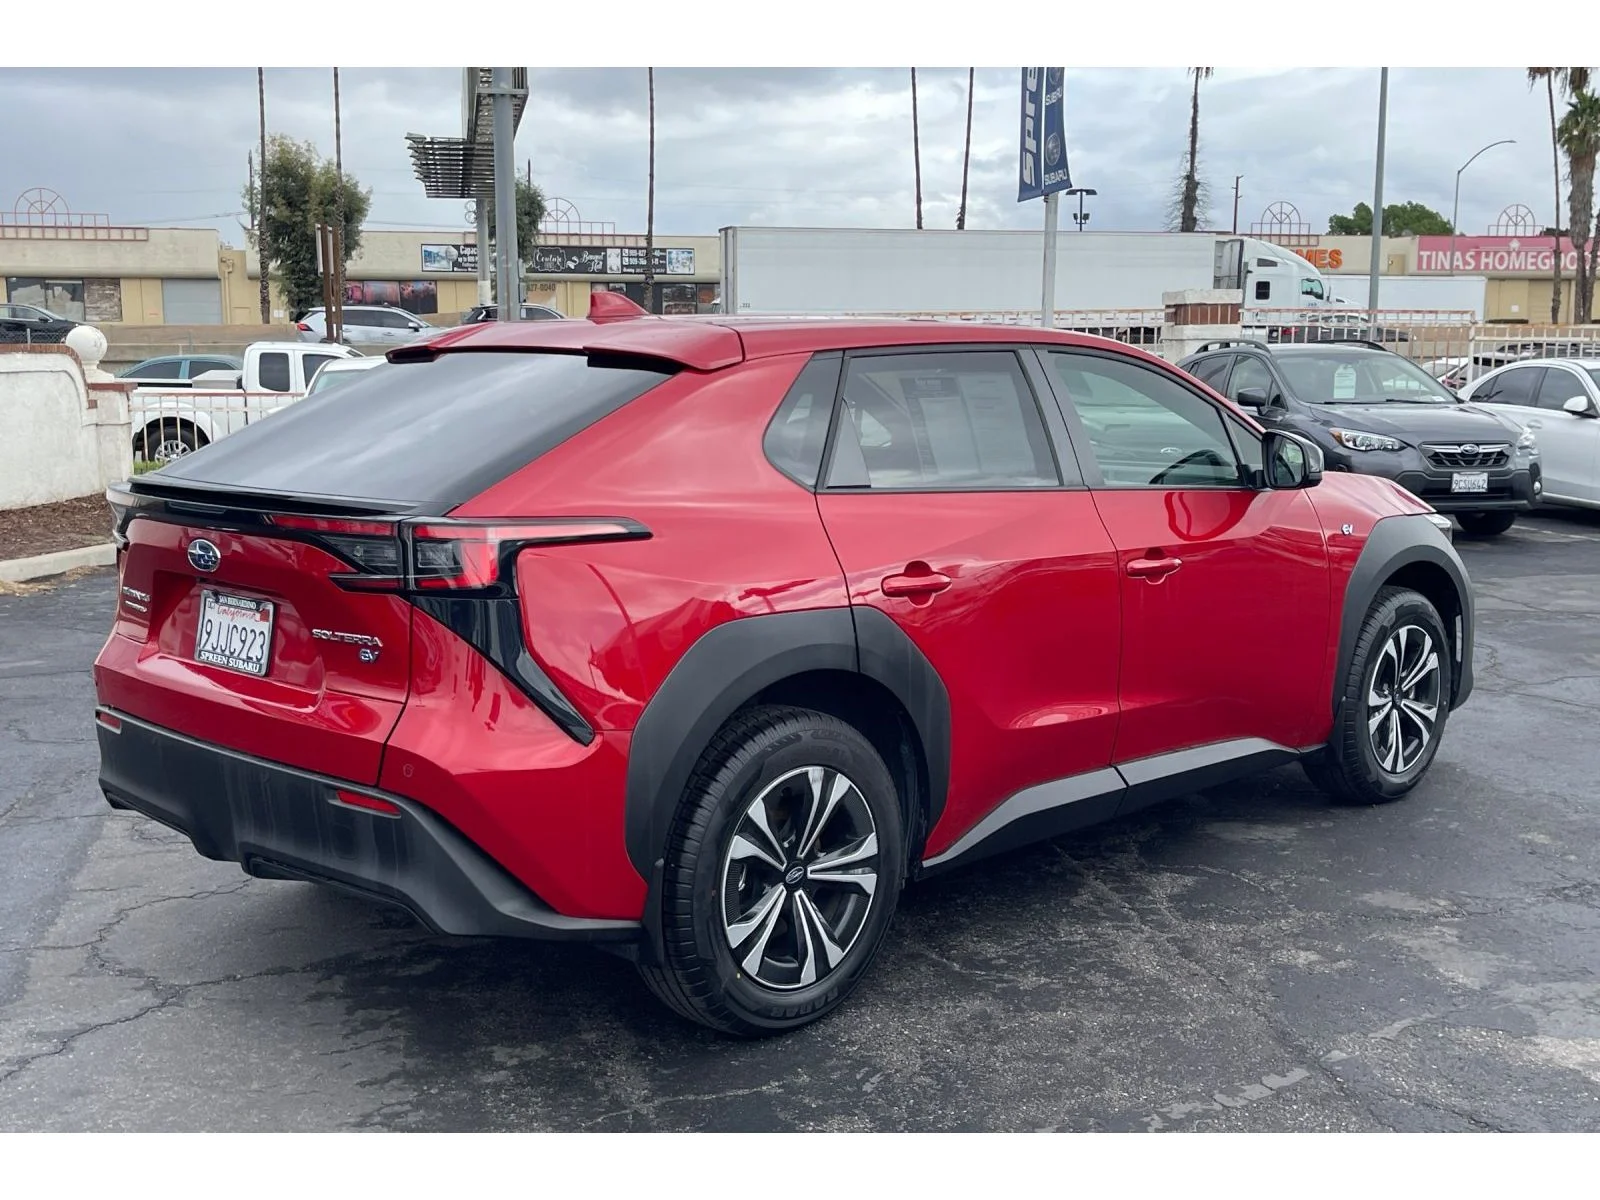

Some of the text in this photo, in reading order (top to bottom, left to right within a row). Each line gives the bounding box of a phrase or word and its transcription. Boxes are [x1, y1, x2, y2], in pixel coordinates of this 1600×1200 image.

[1044, 168, 1068, 186] SUBARU
[1296, 248, 1343, 269] MES
[1419, 250, 1476, 270] TINAS
[202, 619, 266, 663] 9JJC923
[312, 629, 383, 647] SOLTERRA
[200, 651, 260, 673] SPREEN SUBARU
